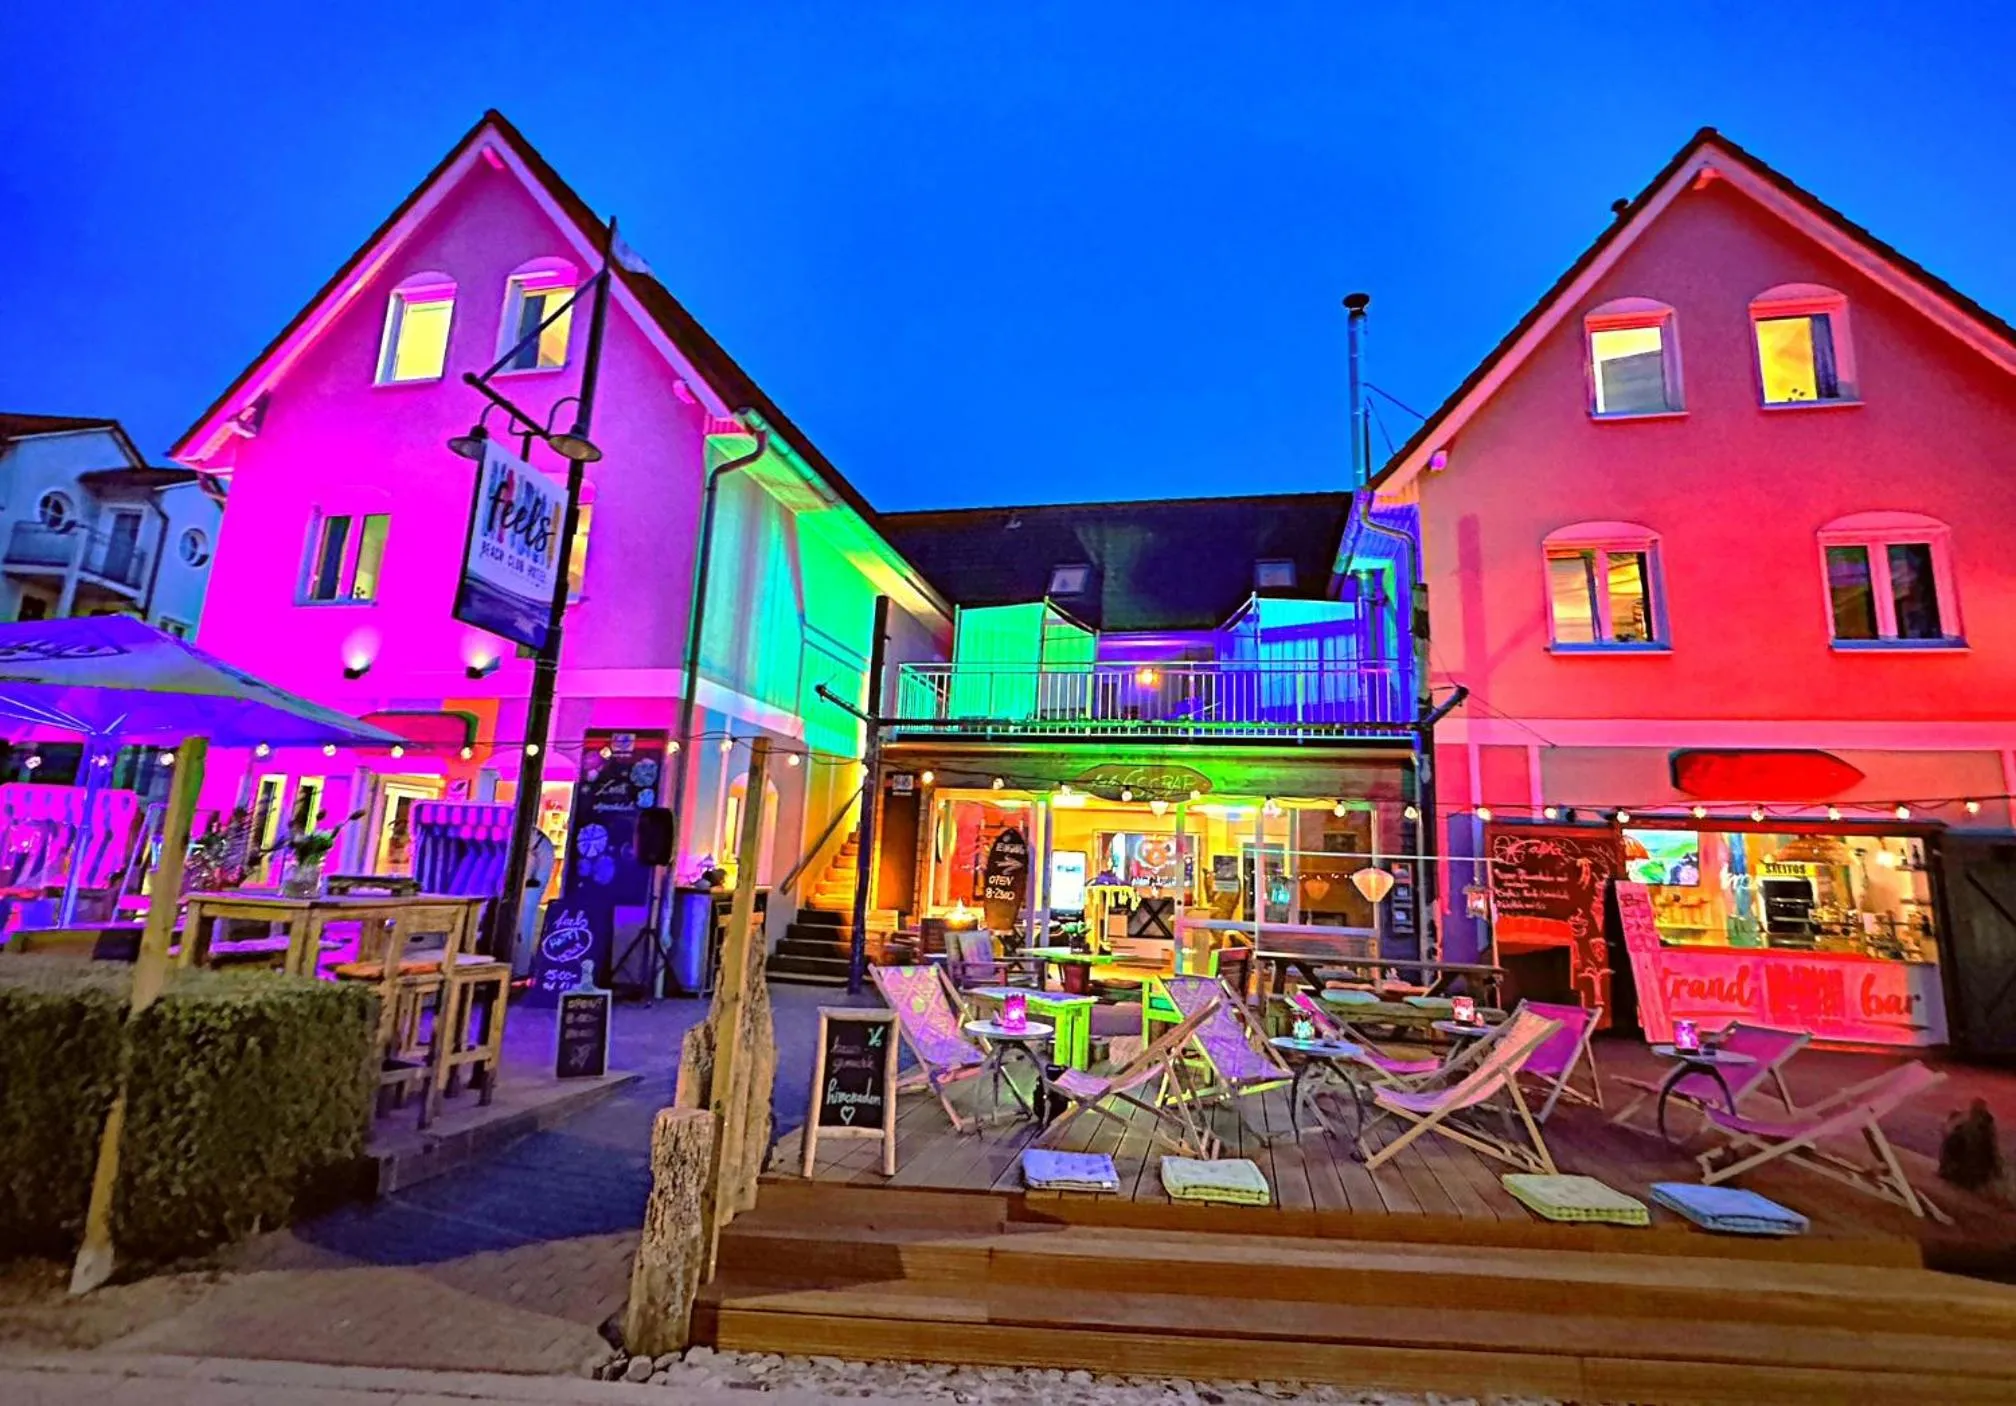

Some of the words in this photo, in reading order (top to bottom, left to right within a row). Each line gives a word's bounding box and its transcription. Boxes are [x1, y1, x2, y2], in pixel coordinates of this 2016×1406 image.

[488, 481, 556, 553] feels
[1765, 864, 1807, 875] SALITOS
[1663, 965, 1757, 1008] trand
[1861, 973, 1921, 1017] bar
